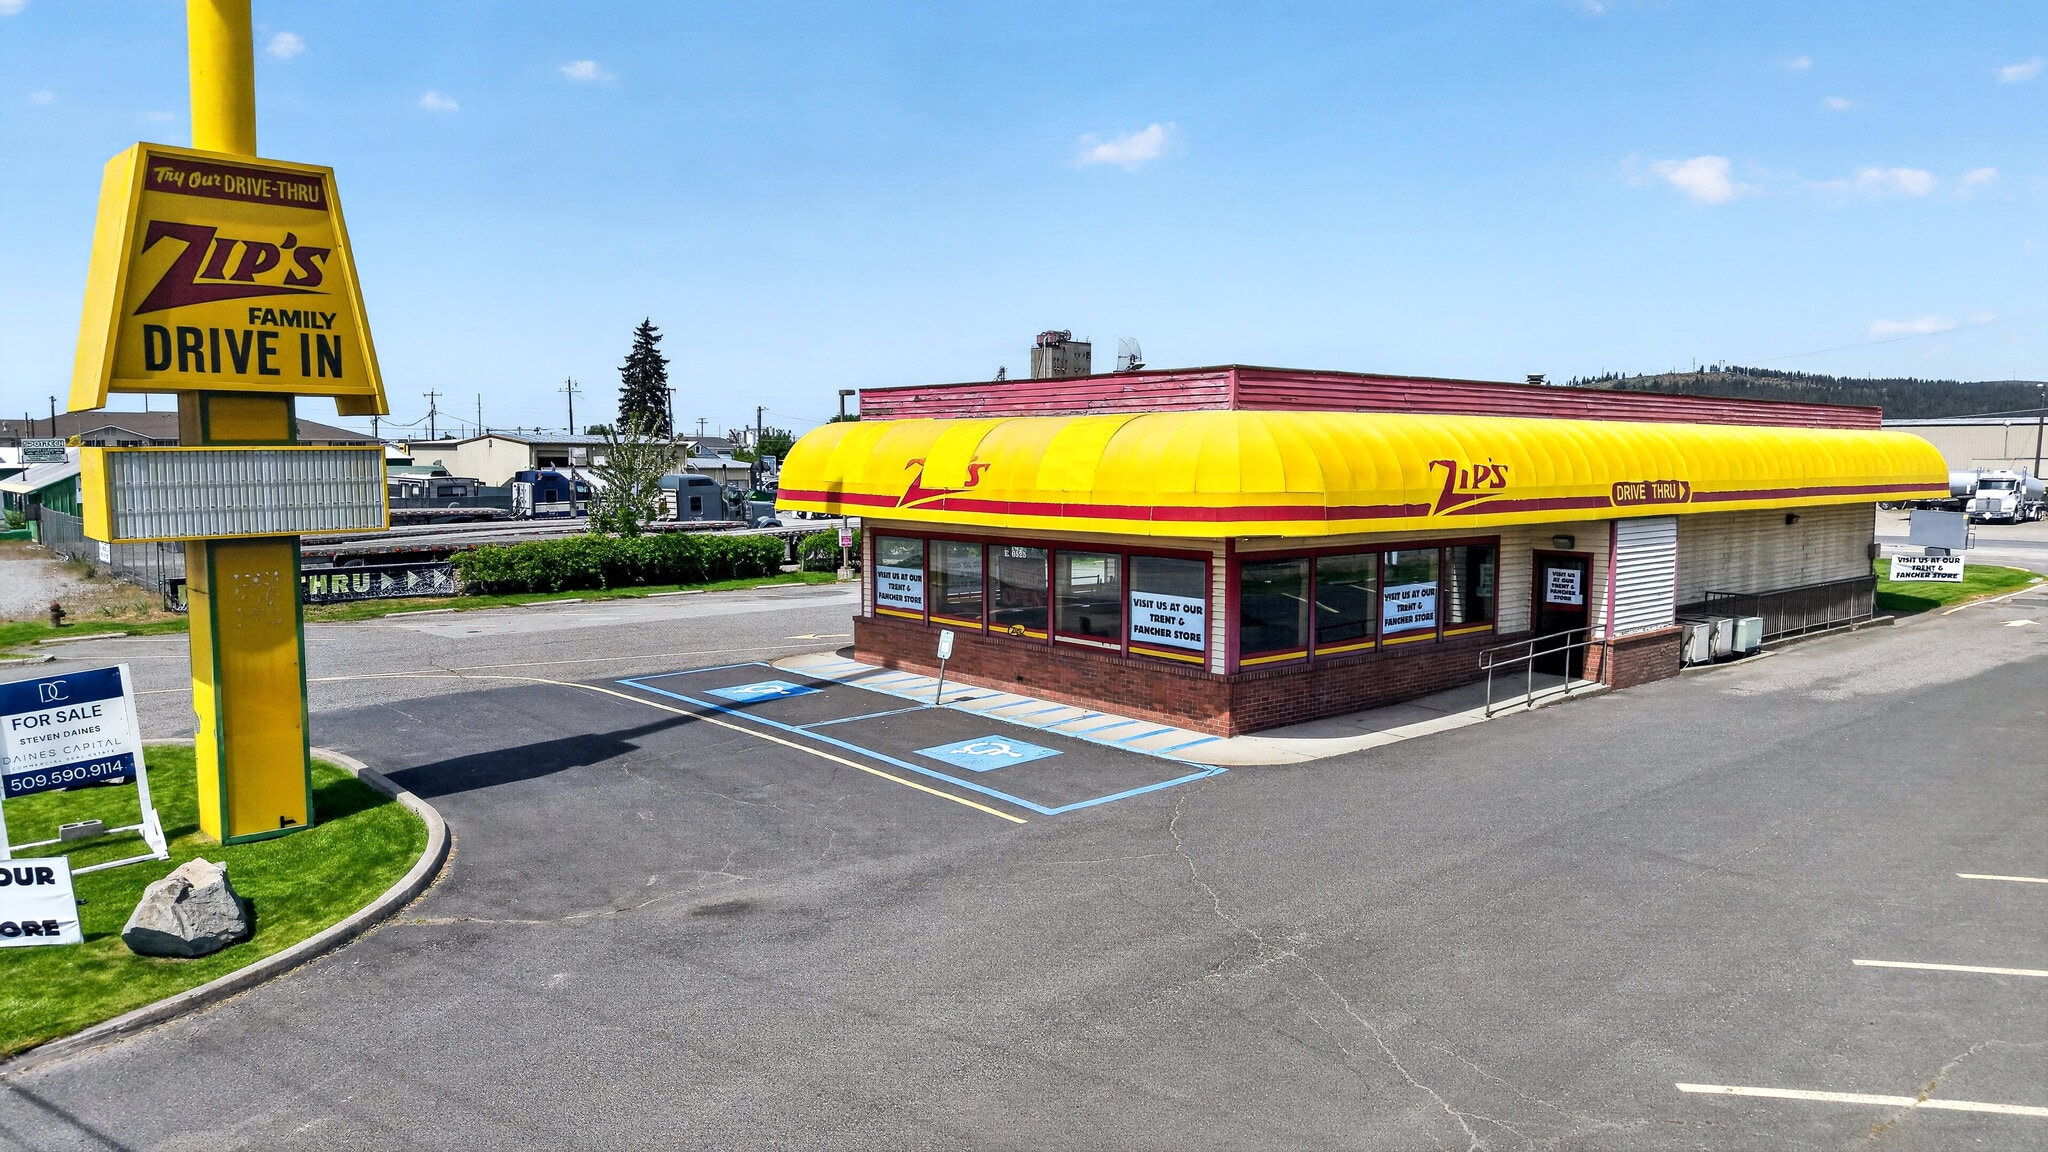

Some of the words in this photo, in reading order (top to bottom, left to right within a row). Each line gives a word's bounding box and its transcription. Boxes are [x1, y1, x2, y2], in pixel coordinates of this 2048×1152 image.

[153, 166, 185, 188] Try
[188, 171, 221, 189] Our
[224, 174, 319, 203] DRIVE-THRU
[132, 220, 331, 316] ZIP'S
[248, 307, 337, 330] FAMILY
[143, 324, 280, 377] DRIVE
[300, 333, 343, 379] IN
[1616, 484, 1646, 501] DRIVE
[1652, 483, 1676, 499] THRU
[301, 572, 370, 595] HRU
[877, 571, 891, 580] VISIT
[892, 572, 900, 580] US
[900, 573, 909, 581] AT
[909, 574, 922, 583] OUR
[878, 592, 903, 602] FANCHER
[904, 595, 922, 604] STORE
[1384, 591, 1401, 602] VISIT
[1401, 591, 1411, 600] US
[1411, 590, 1420, 598] AT
[1421, 588, 1435, 597] OUR
[1133, 598, 1154, 609] VISIT
[1156, 601, 1168, 611] US
[1169, 603, 1181, 612] AT
[1183, 604, 1203, 615] OUR
[1149, 613, 1176, 625] TRENT
[1178, 617, 1185, 626] &
[1384, 615, 1413, 627] FANCHER
[1414, 612, 1434, 622] STORE
[1133, 624, 1172, 638] FANCHER
[1174, 630, 1202, 642] STORE
[38, 680, 70, 703] DC
[12, 713, 51, 731] FOR
[56, 704, 103, 723] SALE
[20, 732, 60, 746] STEVEN
[63, 725, 101, 738] DAINES
[3, 749, 57, 765] DAINES
[63, 738, 122, 754] CAPITAL
[11, 760, 124, 791] 509.590.9114
[0, 867, 56, 887] OUR
